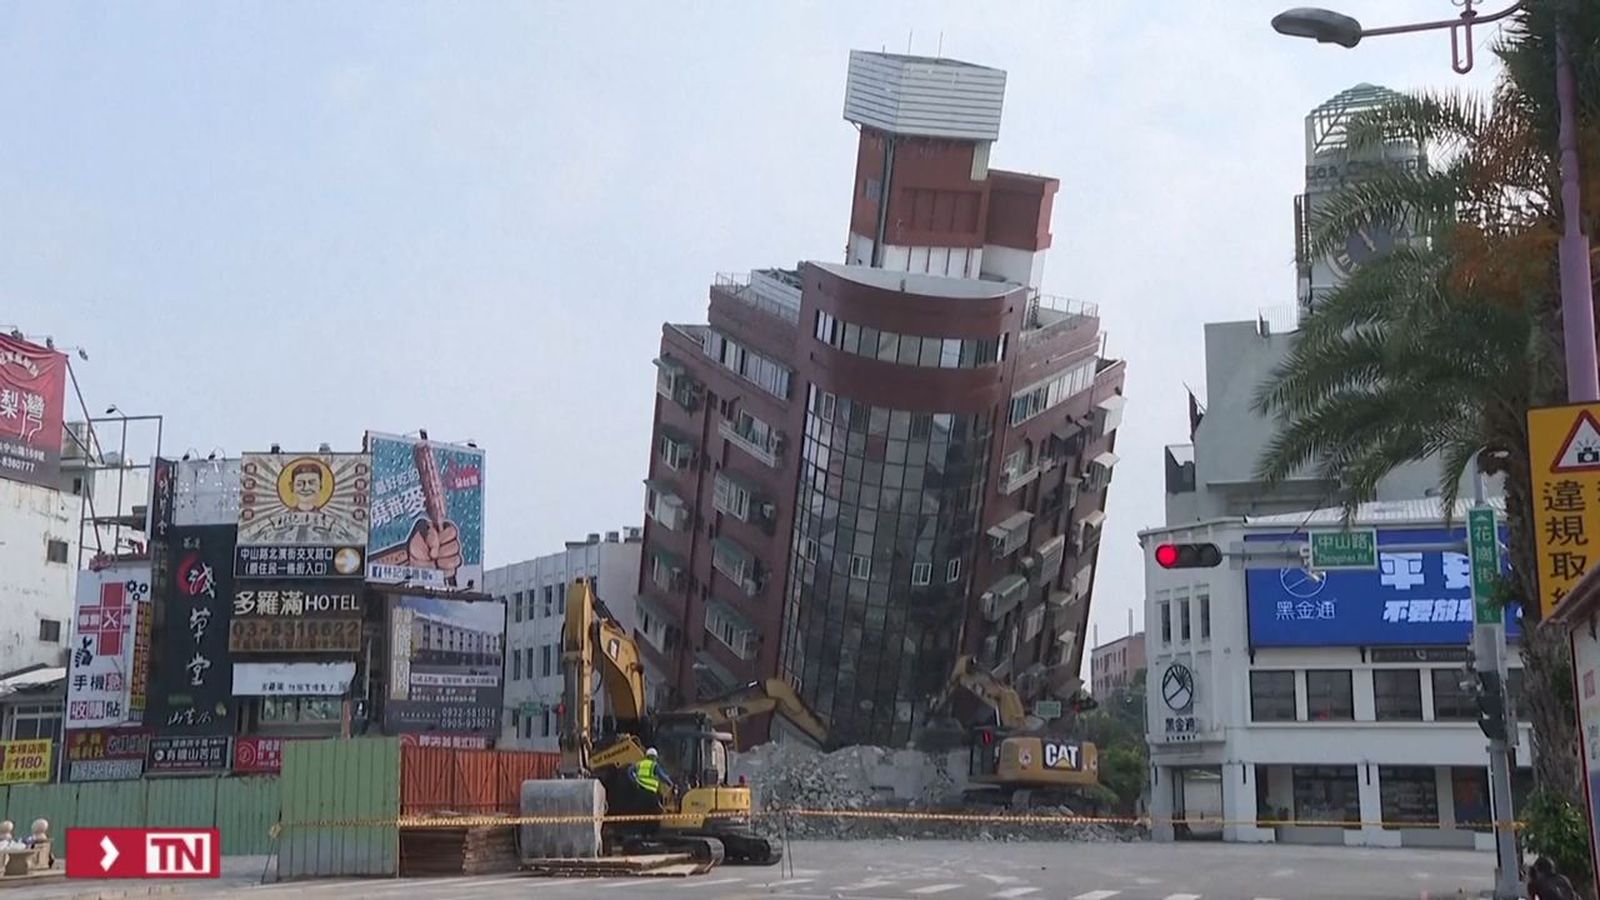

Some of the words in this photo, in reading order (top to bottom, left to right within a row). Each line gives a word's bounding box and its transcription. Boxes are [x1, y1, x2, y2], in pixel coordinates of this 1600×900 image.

[1319, 534, 1367, 549] 中山路
[240, 547, 334, 560] 中山路北濱街交叉路口
[1276, 600, 1335, 620] 黑金通
[1045, 743, 1078, 768] CAT
